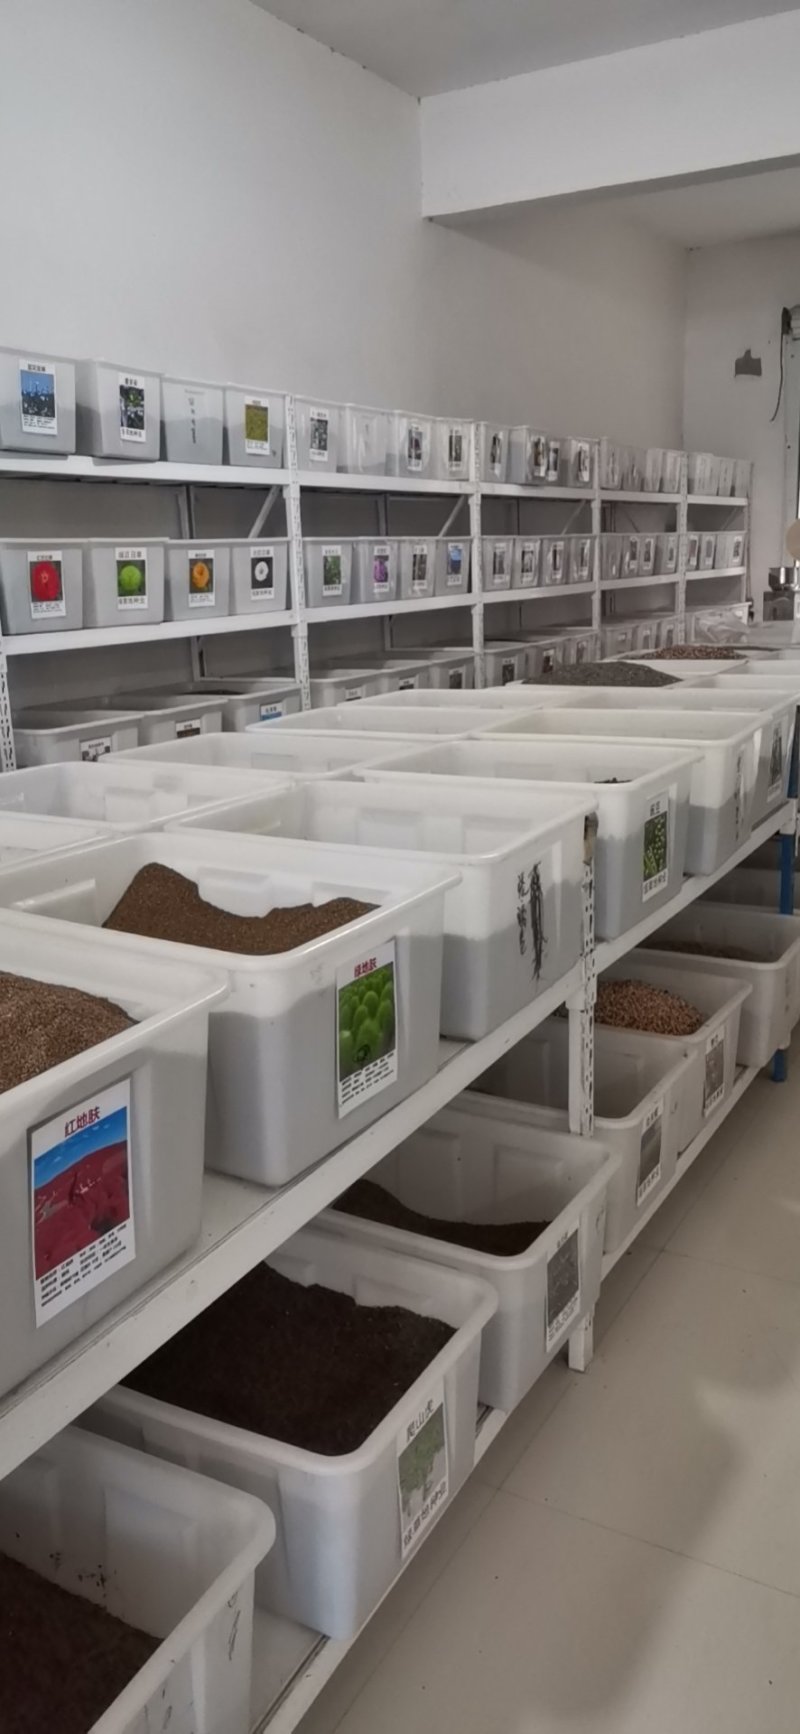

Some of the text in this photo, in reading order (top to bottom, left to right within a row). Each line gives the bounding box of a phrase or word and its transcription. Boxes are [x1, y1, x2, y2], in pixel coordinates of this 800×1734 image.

[354, 957, 377, 978] 绿地肤
[64, 1106, 101, 1138] 红地肤
[406, 1398, 434, 1443] 爬山虎
